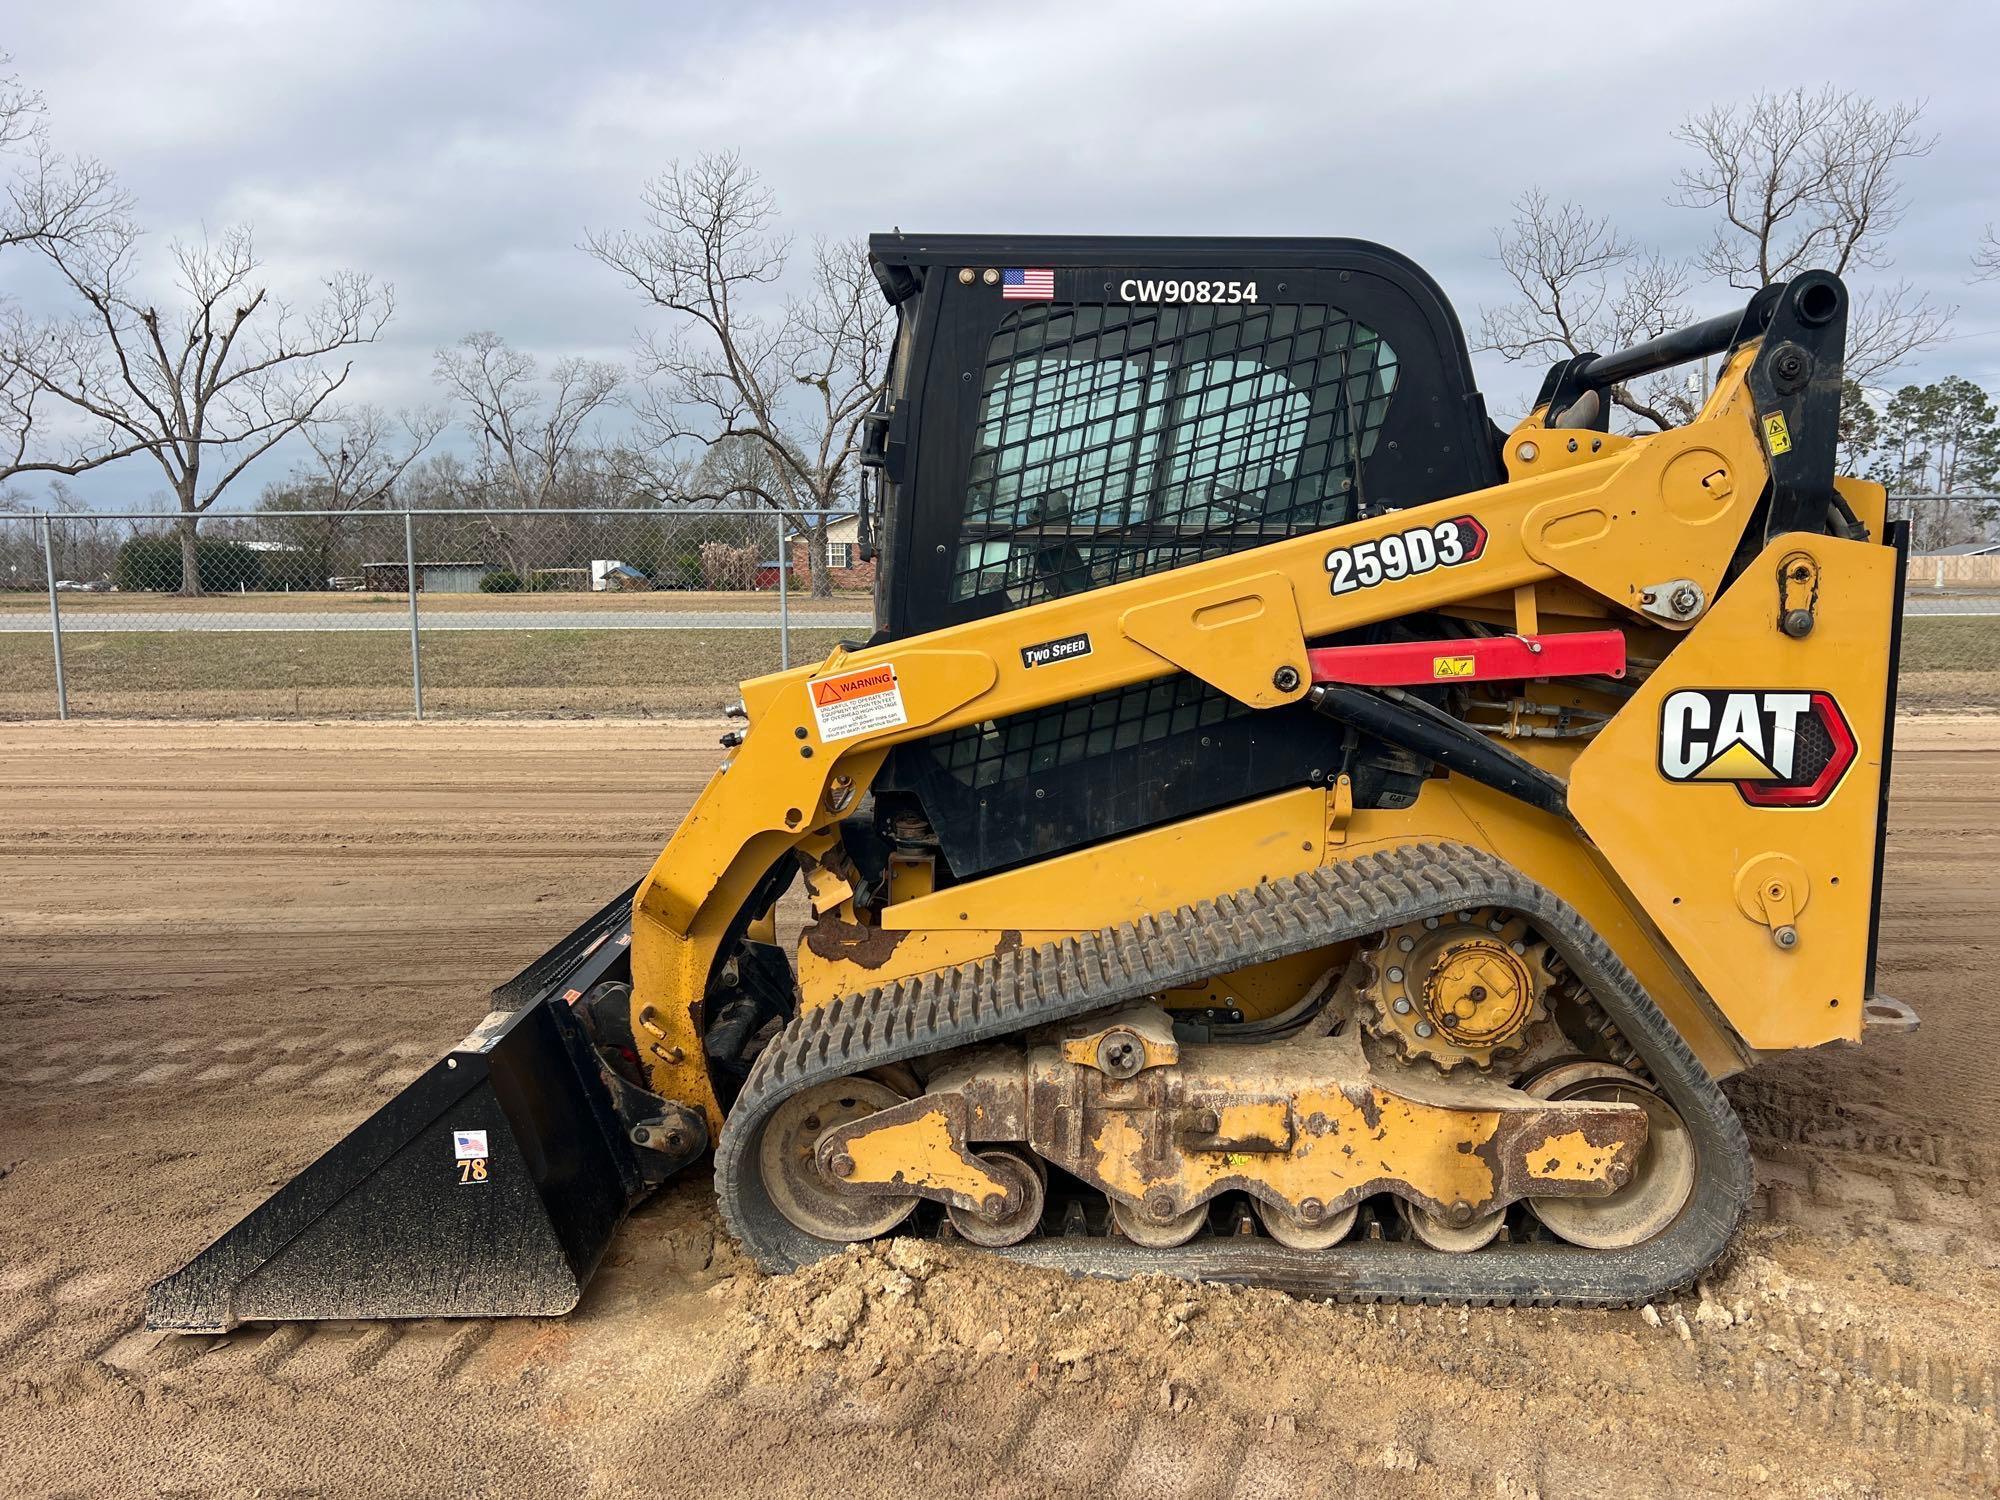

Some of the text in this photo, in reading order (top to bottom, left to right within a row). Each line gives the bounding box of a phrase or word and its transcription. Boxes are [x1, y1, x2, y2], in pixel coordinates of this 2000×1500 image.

[1119, 279, 1259, 304] CW908254
[1326, 522, 1464, 594] 259D3
[840, 673, 890, 692] WARNING
[858, 694, 881, 704] OPERATE
[821, 707, 852, 718] EQUIPMENT
[852, 702, 871, 710] WITHIN
[831, 711, 859, 721] OVERHEAD
[1662, 691, 1811, 779] CAT
